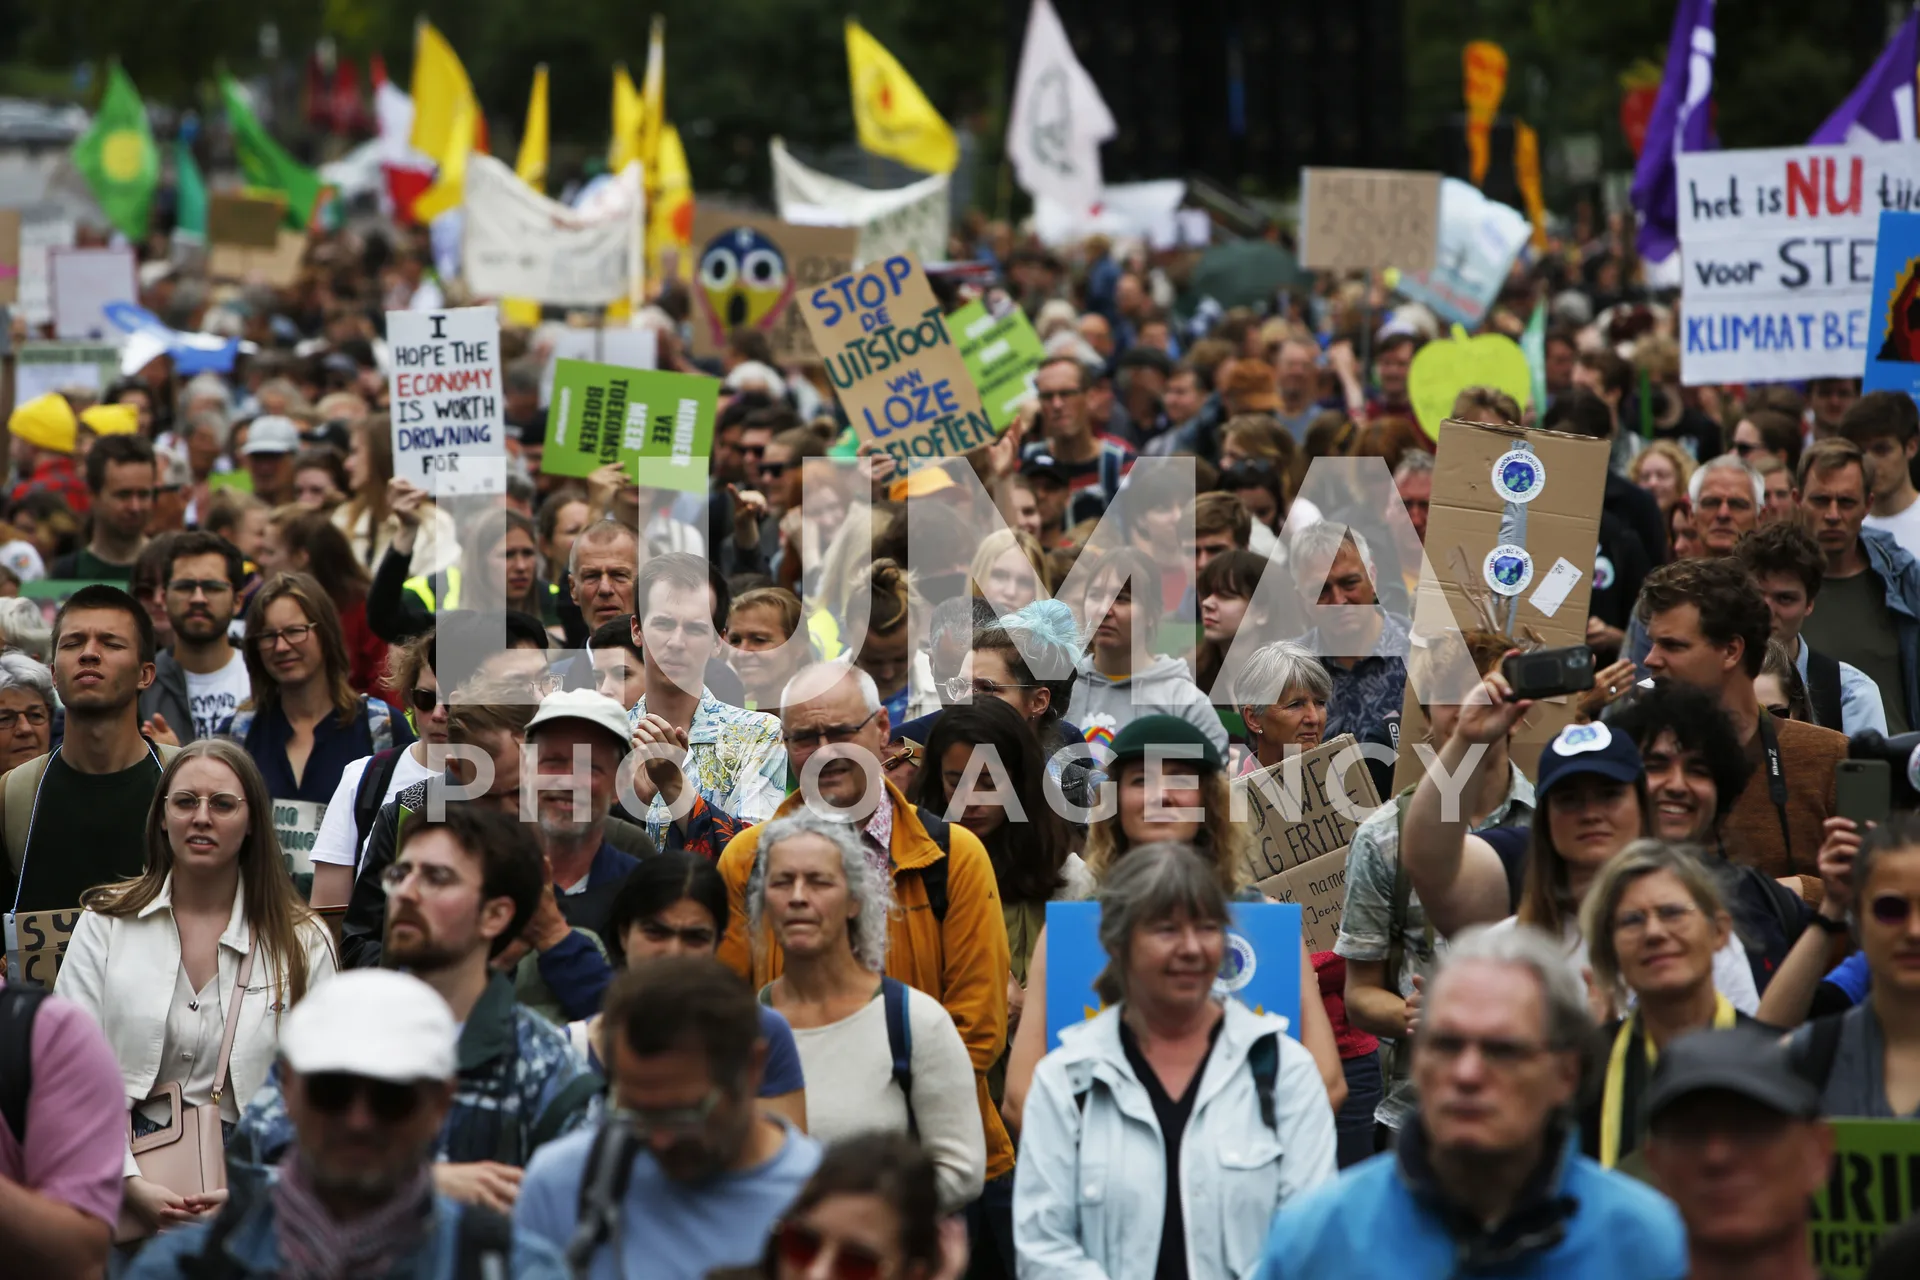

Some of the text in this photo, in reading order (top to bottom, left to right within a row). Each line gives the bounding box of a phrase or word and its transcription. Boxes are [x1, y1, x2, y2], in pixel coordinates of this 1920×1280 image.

[1689, 174, 1742, 221] het
[1756, 185, 1783, 215] is
[1785, 155, 1865, 219] NU
[1694, 260, 1763, 287] voor
[810, 255, 912, 328] STOP
[428, 315, 448, 339] I
[860, 306, 890, 333] DE
[395, 341, 489, 368] HOPE THE
[823, 306, 951, 390] UITSTOOT
[396, 368, 493, 398] ECONOMY
[884, 368, 924, 394] VAN
[398, 395, 496, 423] IS WORTH
[579, 385, 605, 454] BOEREN
[862, 378, 960, 438] LOZE
[398, 424, 492, 452] DROWNING
[623, 401, 649, 451] MEER
[652, 415, 673, 445] VEE
[671, 398, 698, 467] MINDER
[421, 453, 460, 475] FOR
[1771, 757, 1780, 776] Nikon
[275, 806, 298, 826] NO
[275, 829, 318, 851] ING
[1308, 869, 1346, 896] name
[1306, 901, 1343, 925] Joost
